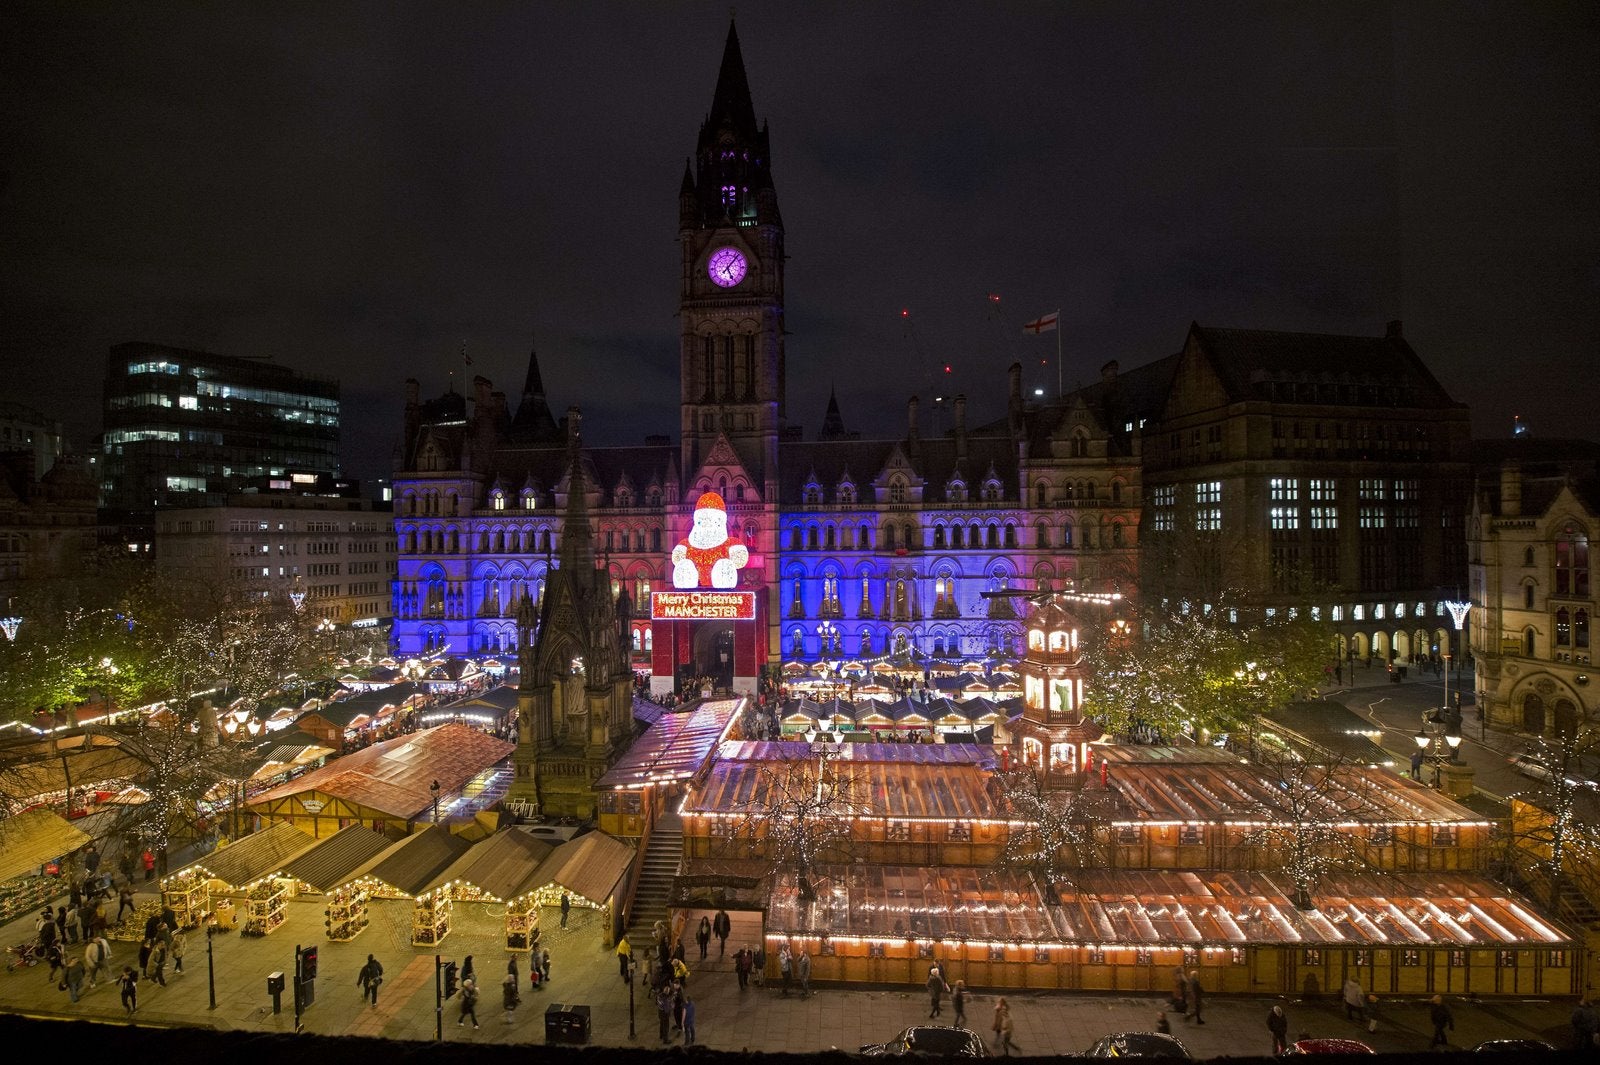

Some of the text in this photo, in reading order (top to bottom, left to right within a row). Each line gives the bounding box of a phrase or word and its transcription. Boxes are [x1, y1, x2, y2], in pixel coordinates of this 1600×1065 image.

[658, 593, 743, 606] Merry Christmas
[665, 605, 737, 617] MANCHESTER
